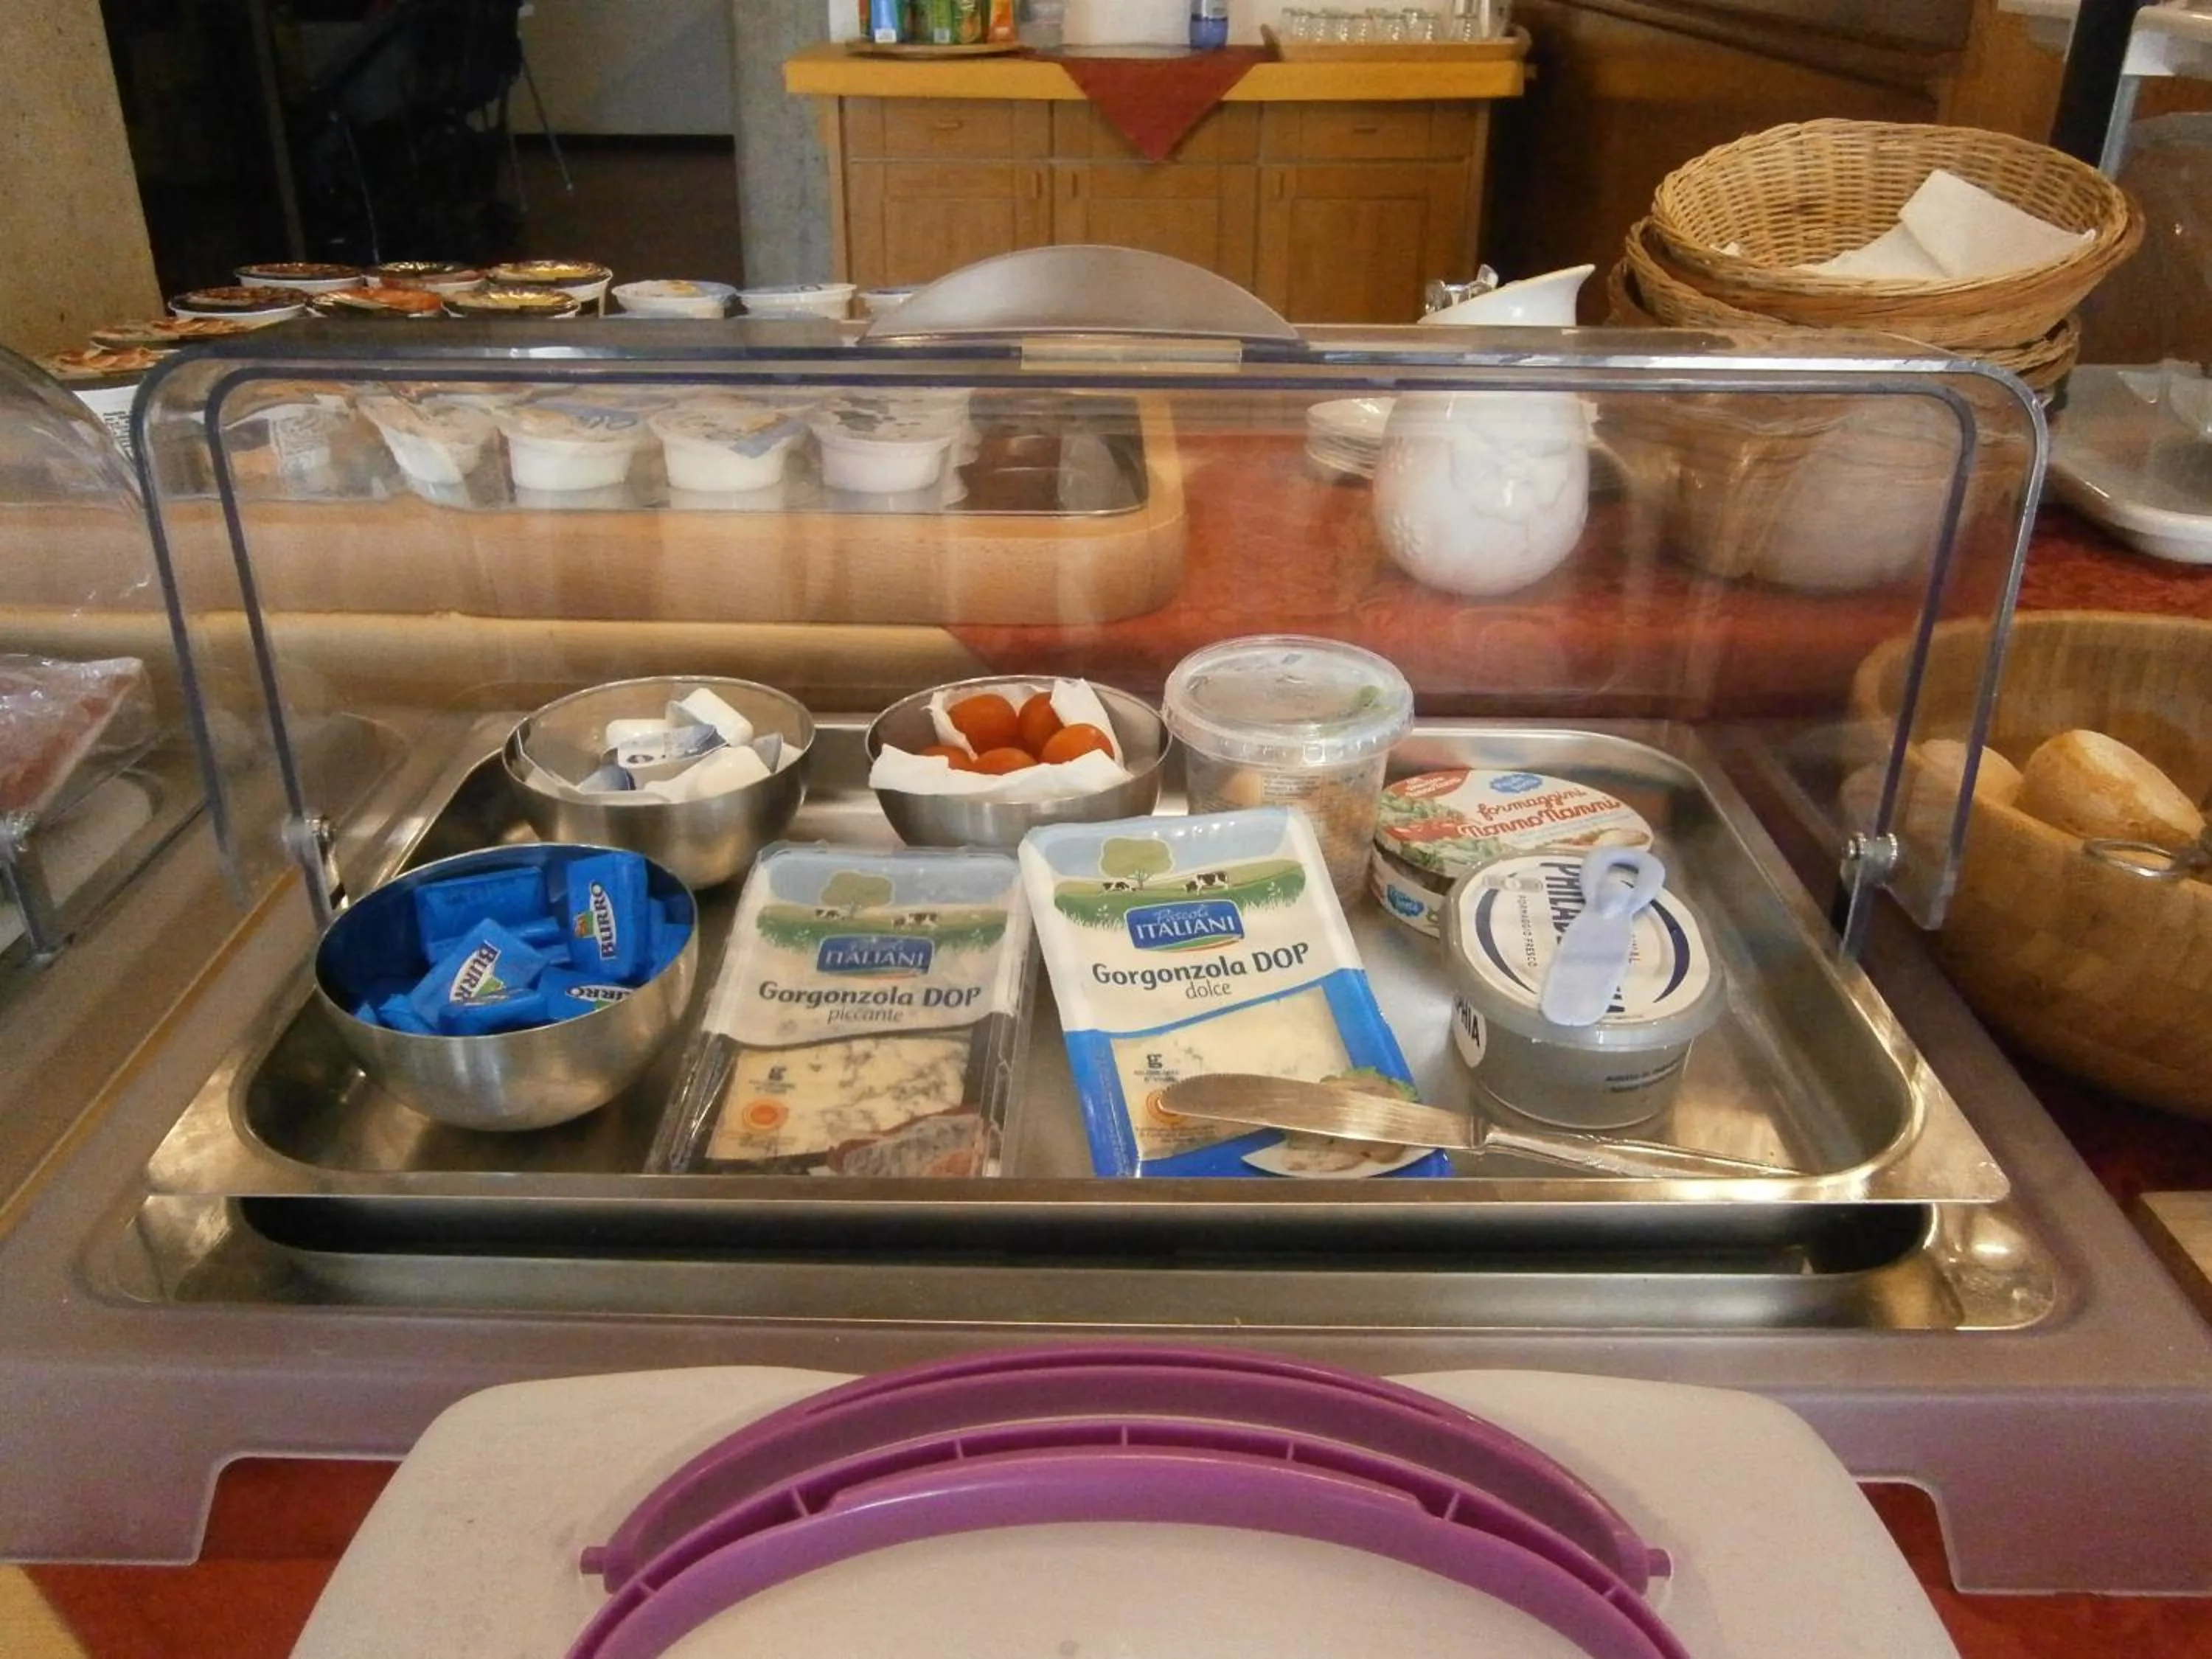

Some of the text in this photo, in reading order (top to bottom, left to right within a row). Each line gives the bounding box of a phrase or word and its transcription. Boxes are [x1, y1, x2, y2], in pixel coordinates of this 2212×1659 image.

[591, 882, 616, 958] BURRO
[1136, 916, 1236, 939] ITALIANI
[455, 941, 500, 1002] BURR
[1092, 942, 1310, 990] Gorgonzola DOP
[759, 981, 981, 1009] Gorgonzola DOP
[1185, 980, 1232, 1000] dolce
[827, 1007, 904, 1024] piccante
